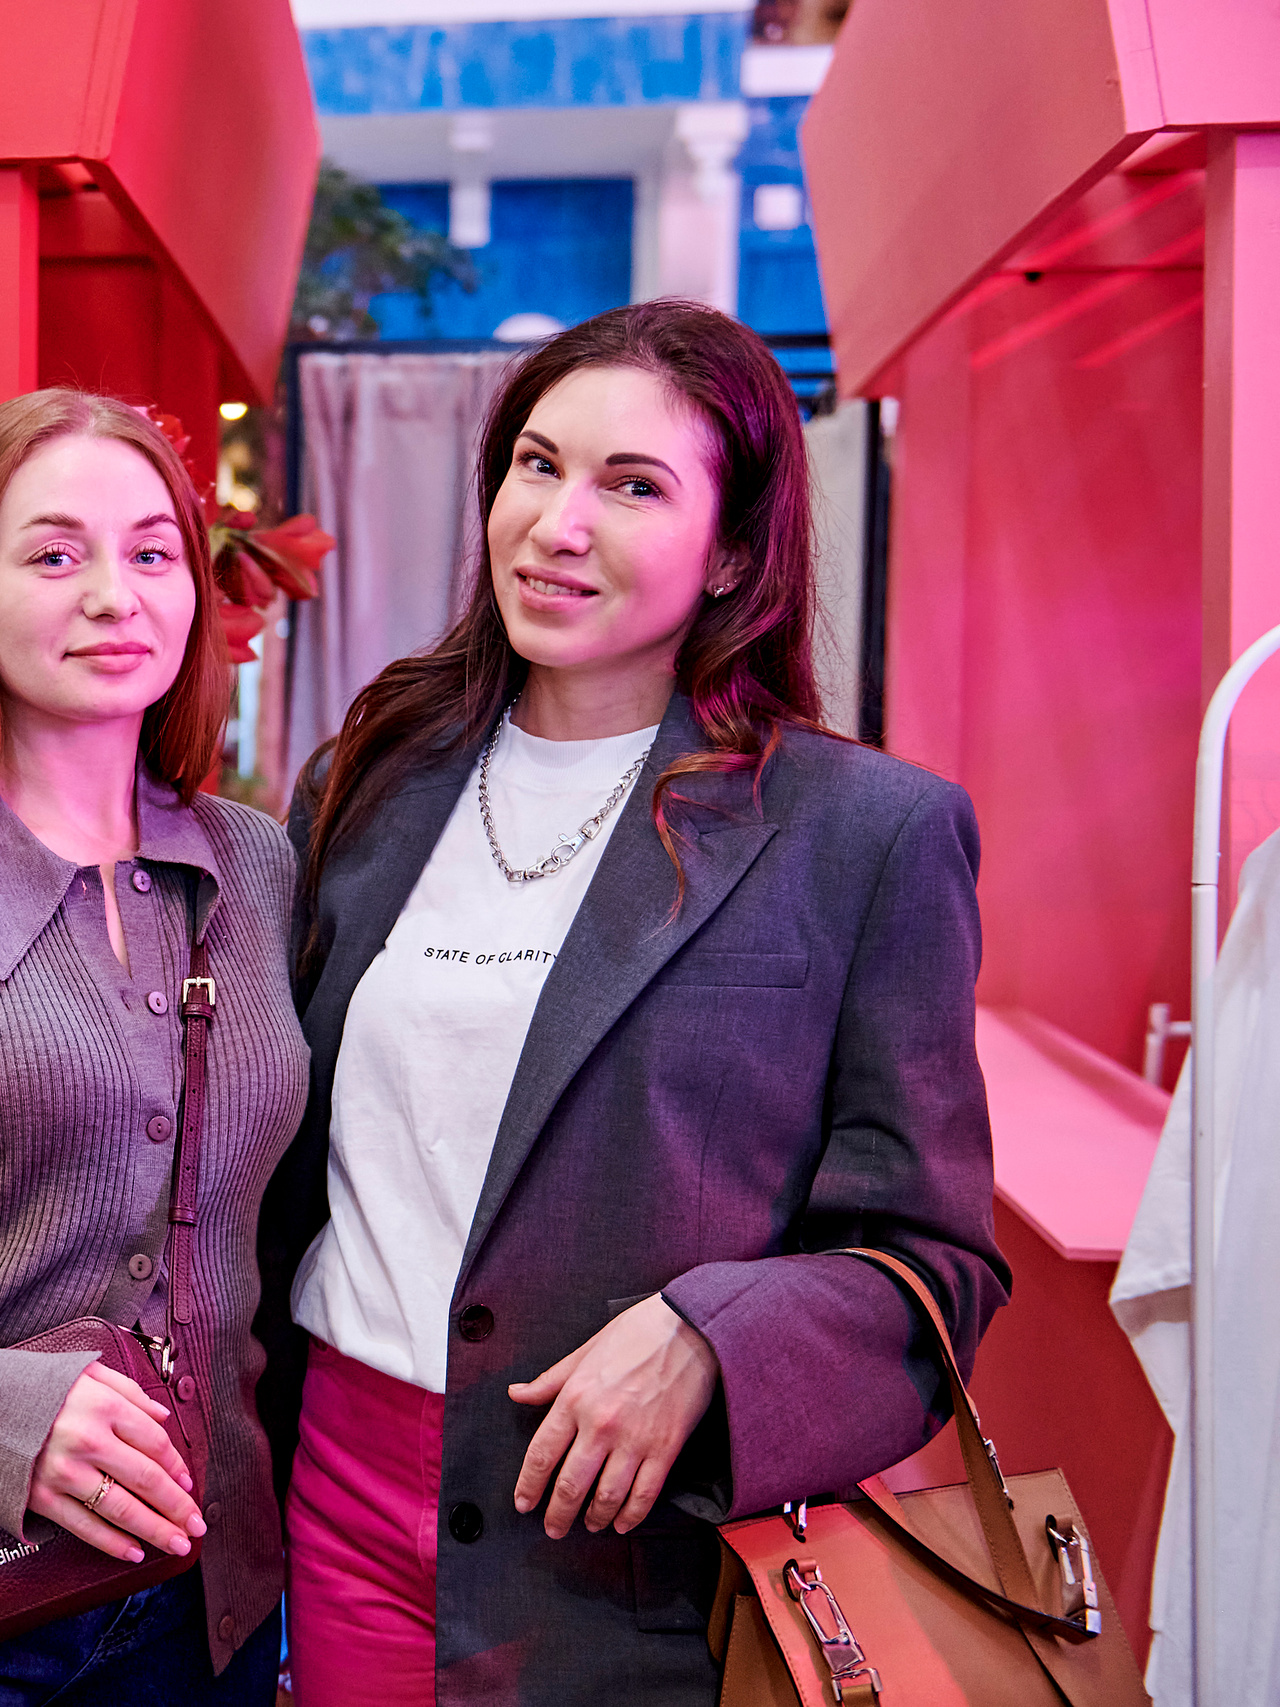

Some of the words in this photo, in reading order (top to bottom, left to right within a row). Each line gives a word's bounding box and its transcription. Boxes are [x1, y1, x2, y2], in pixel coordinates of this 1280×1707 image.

[423, 947, 470, 963] STATE
[475, 954, 496, 965] OF
[498, 949, 557, 964] CLARIT
